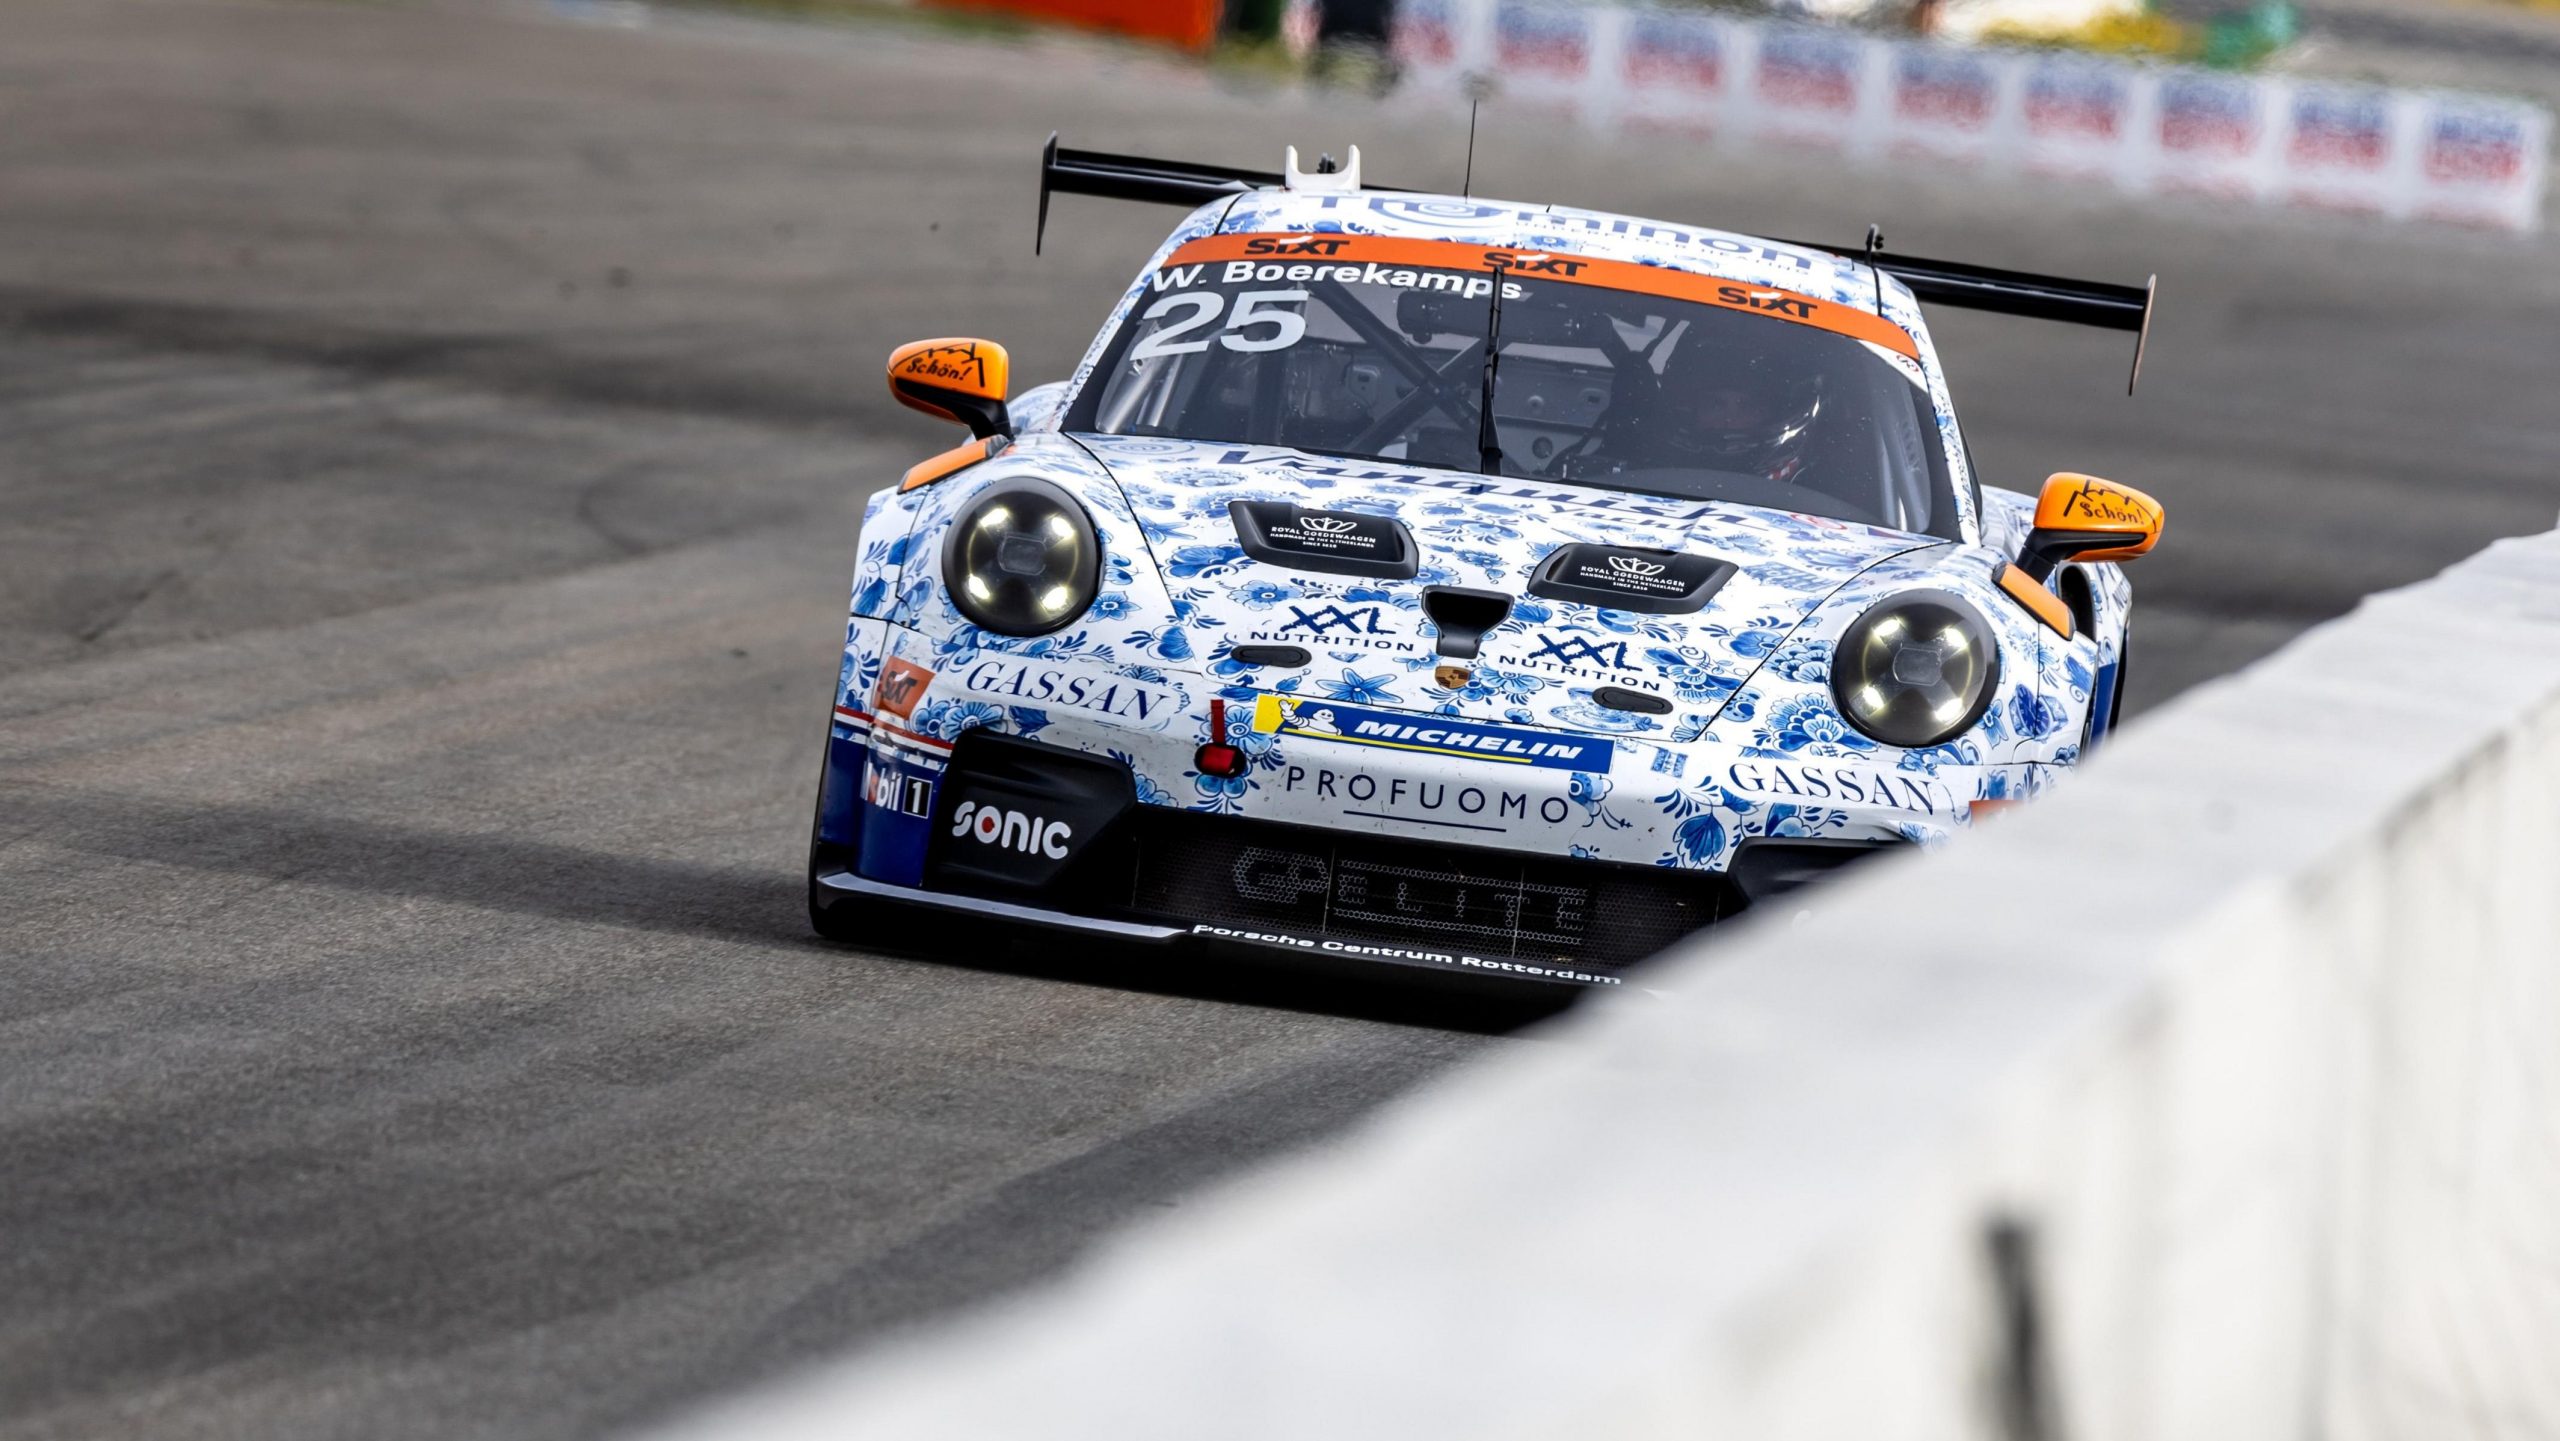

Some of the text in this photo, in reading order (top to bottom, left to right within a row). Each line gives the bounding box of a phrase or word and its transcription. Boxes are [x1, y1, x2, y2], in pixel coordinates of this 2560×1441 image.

[1245, 234, 1350, 257] SIXT
[1153, 260, 1522, 300] W. Boerekamps
[1483, 250, 1588, 278] SIXT
[1717, 286, 1817, 320] SIXT
[1129, 289, 1309, 361] 25
[906, 357, 972, 381] Schön!
[1217, 450, 1769, 532] Vanquish
[2079, 501, 2145, 525] Schön!
[1269, 533, 1306, 541] HANDMADE
[1271, 526, 1376, 544] ROYAL GOEDEWAAGEN
[1580, 572, 1616, 581] HANDMADE
[1640, 581, 1684, 592] NETHERLANDS
[1581, 565, 1685, 587] ROYAL GOEDEWAAGEN
[1280, 604, 1397, 635] XXL
[1250, 631, 1414, 651] NUTRITION
[1528, 634, 1642, 671] XXL
[1499, 654, 1661, 691] NUTRITION
[966, 660, 1168, 722] GASSAN
[1353, 719, 1584, 760] MICHELIN
[911, 781, 923, 813] 1
[1286, 766, 1570, 824] PROFUOMO
[1728, 763, 1934, 814] GASSAN
[1337, 873, 1586, 932] ELITE
[1192, 924, 1622, 985] Porsche Centrum Rotterdam
